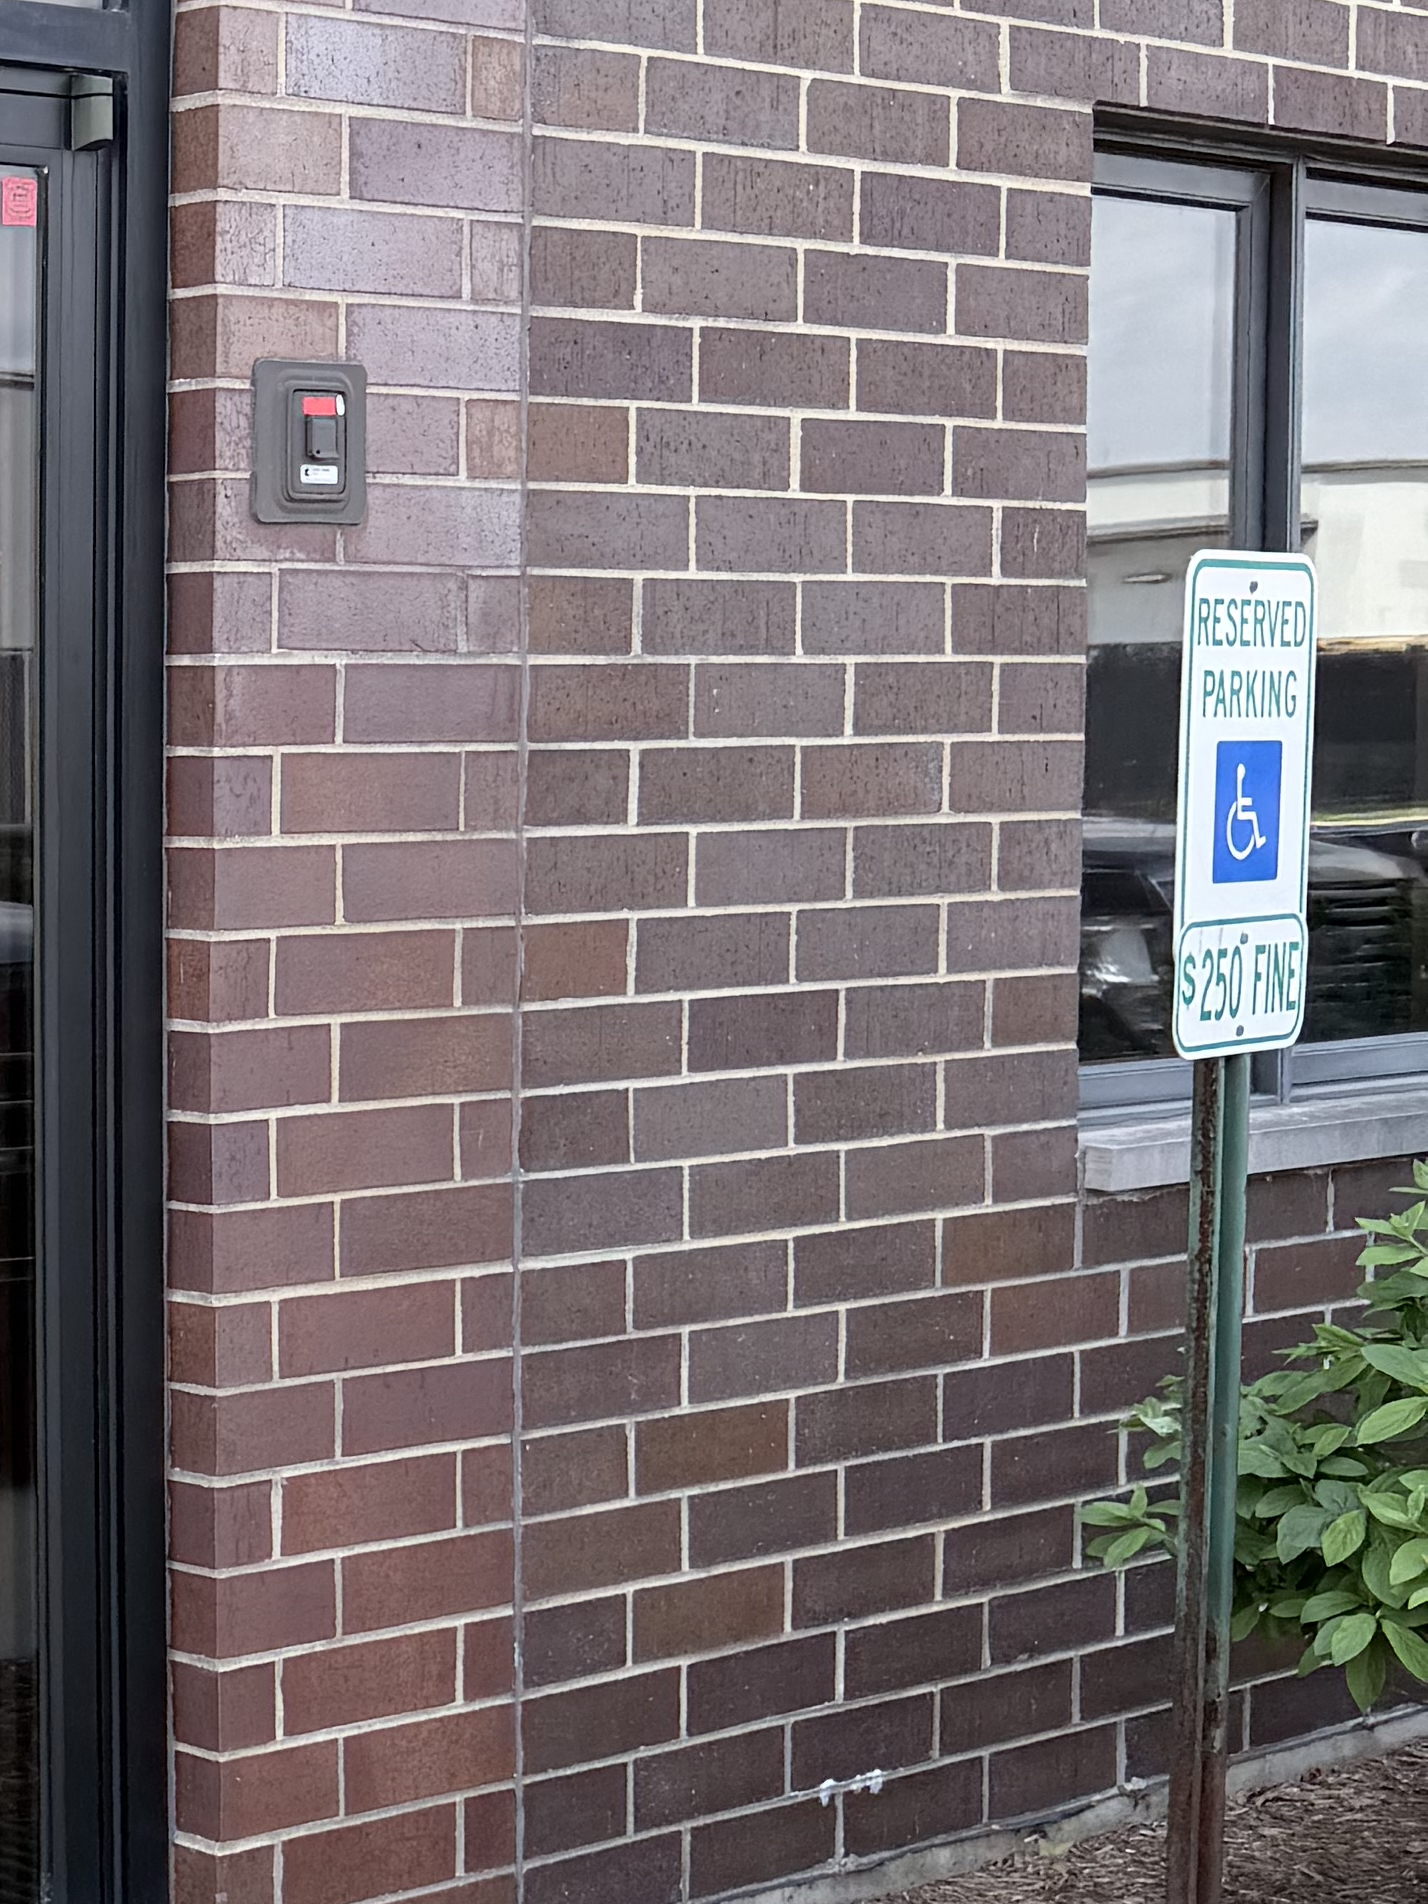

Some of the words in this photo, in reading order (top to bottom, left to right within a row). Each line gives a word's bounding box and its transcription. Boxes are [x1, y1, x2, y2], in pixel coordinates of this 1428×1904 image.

[1199, 598, 1305, 648] RESERVED
[1202, 669, 1297, 719] PARKING
[1182, 948, 1241, 1022] $250
[1254, 941, 1299, 1015] FINE
